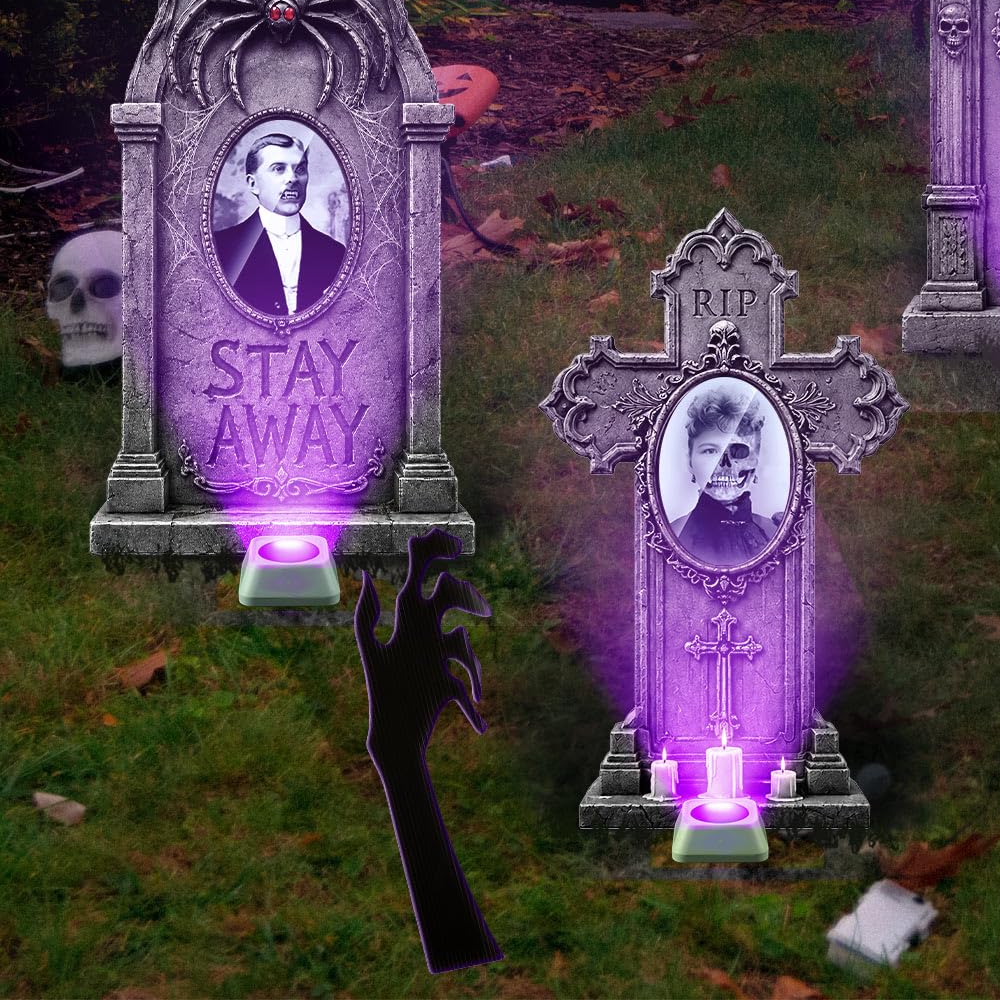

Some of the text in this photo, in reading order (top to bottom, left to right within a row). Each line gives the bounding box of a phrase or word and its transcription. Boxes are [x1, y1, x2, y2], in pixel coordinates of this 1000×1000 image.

[692, 288, 758, 317] RIP
[203, 338, 360, 400] STAY
[206, 403, 370, 468] AWAY
